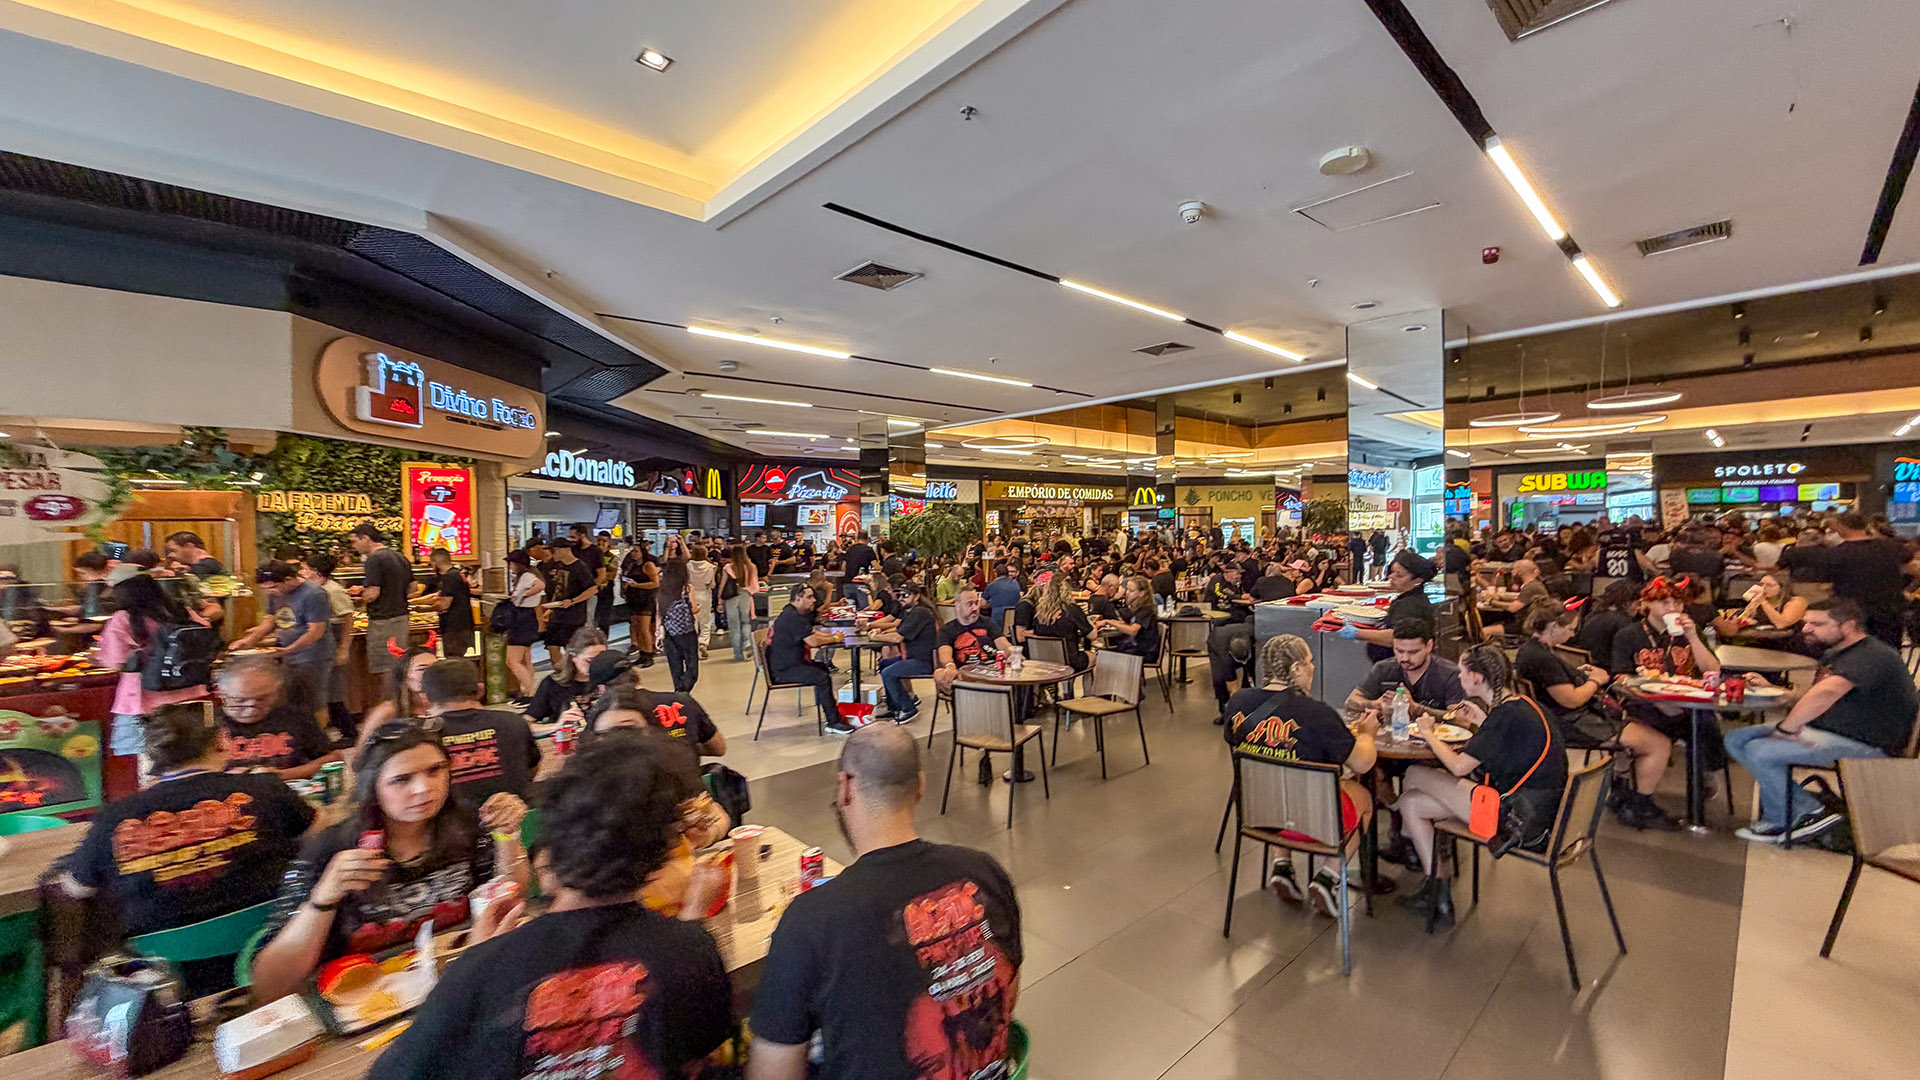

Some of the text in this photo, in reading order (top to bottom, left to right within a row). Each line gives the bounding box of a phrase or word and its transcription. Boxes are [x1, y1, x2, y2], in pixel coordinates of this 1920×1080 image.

[430, 382, 487, 419] Divino
[1714, 463, 1802, 478] SPOLETO
[787, 484, 846, 500] Pizza Hut
[1007, 484, 1114, 500] EMPÓRIO DE COMIDAS
[1208, 489, 1253, 502] PONCHO
[288, 492, 372, 514] FAZENDA
[1606, 558, 1629, 577] 20
